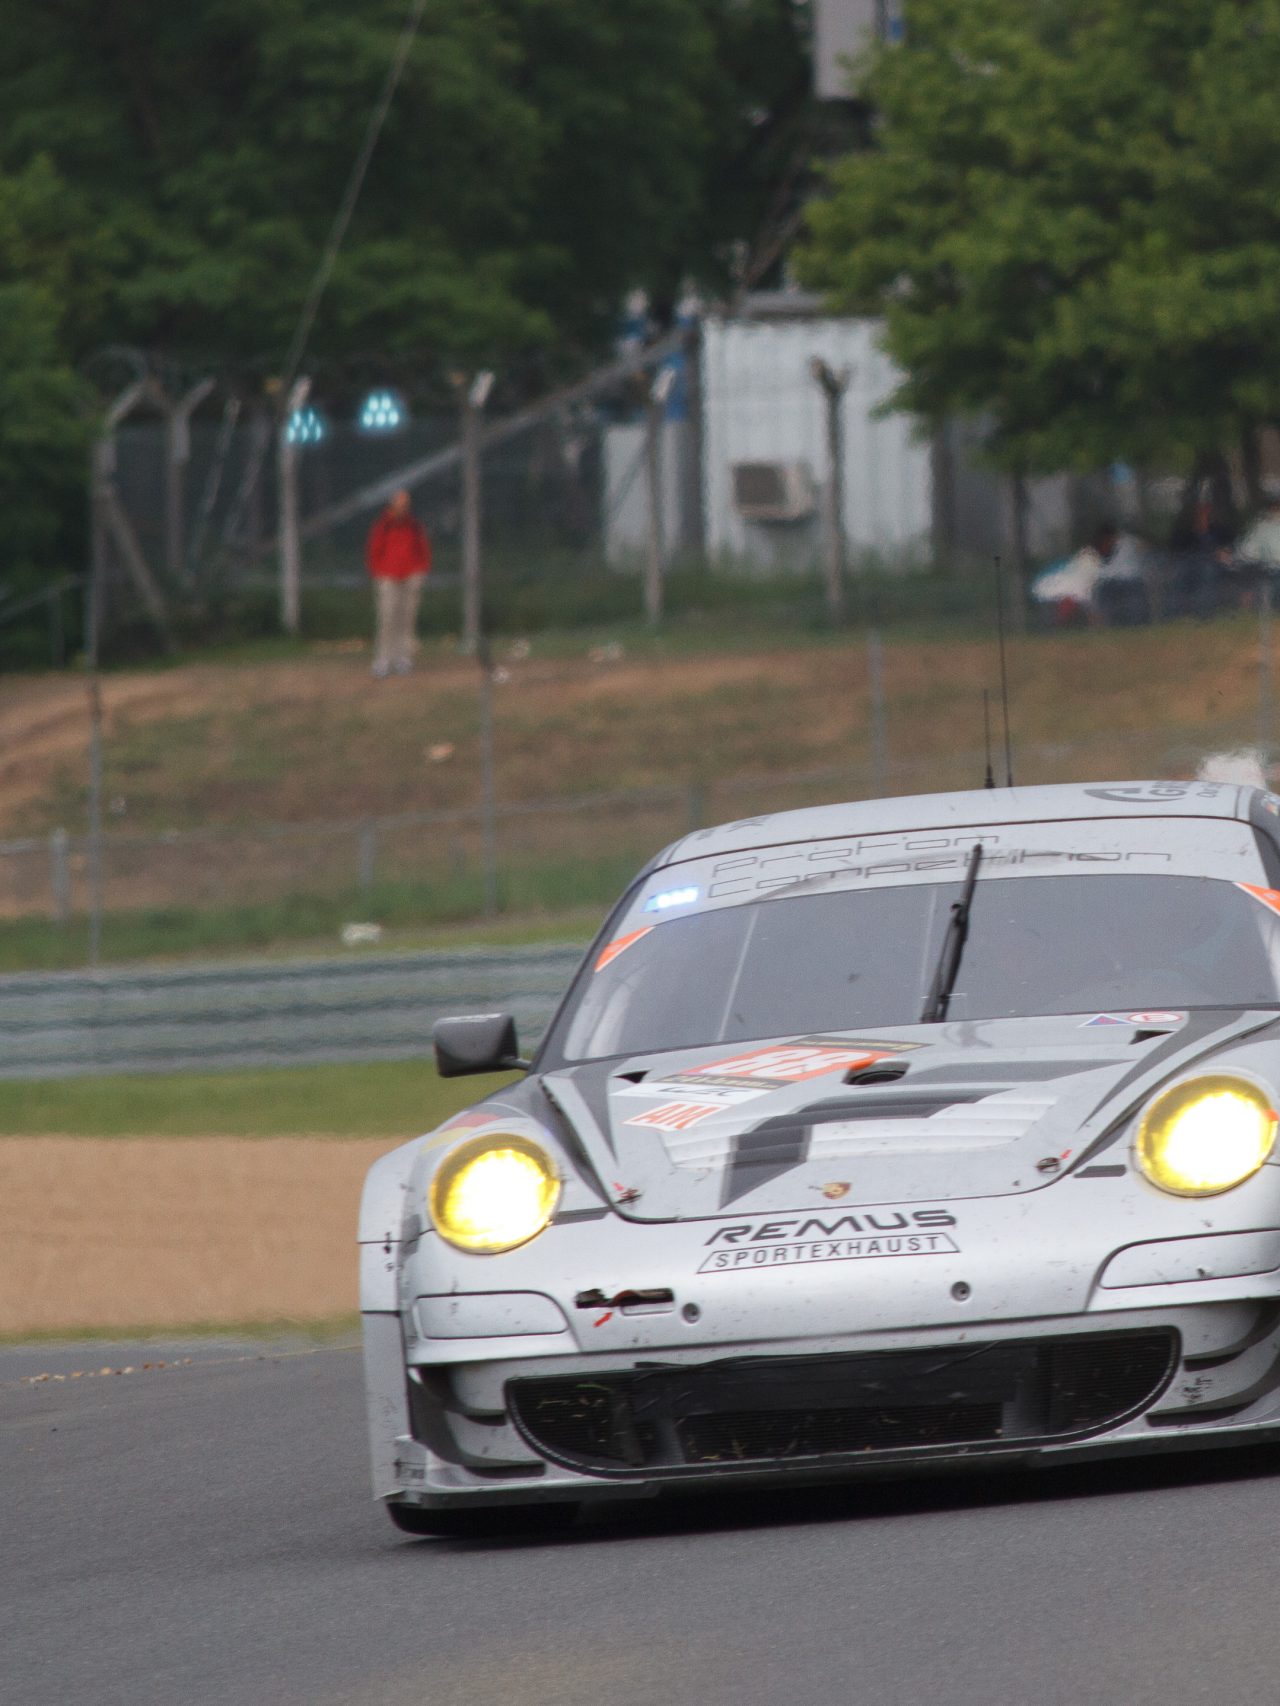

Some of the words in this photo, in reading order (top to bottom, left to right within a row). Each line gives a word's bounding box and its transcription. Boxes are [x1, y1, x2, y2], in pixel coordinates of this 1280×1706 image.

[712, 836, 999, 878] Proton
[700, 1048, 873, 1077] 88
[633, 1103, 722, 1130] AM
[704, 1209, 957, 1246] REMUS
[715, 1236, 939, 1268] SPORTEXHAUST
